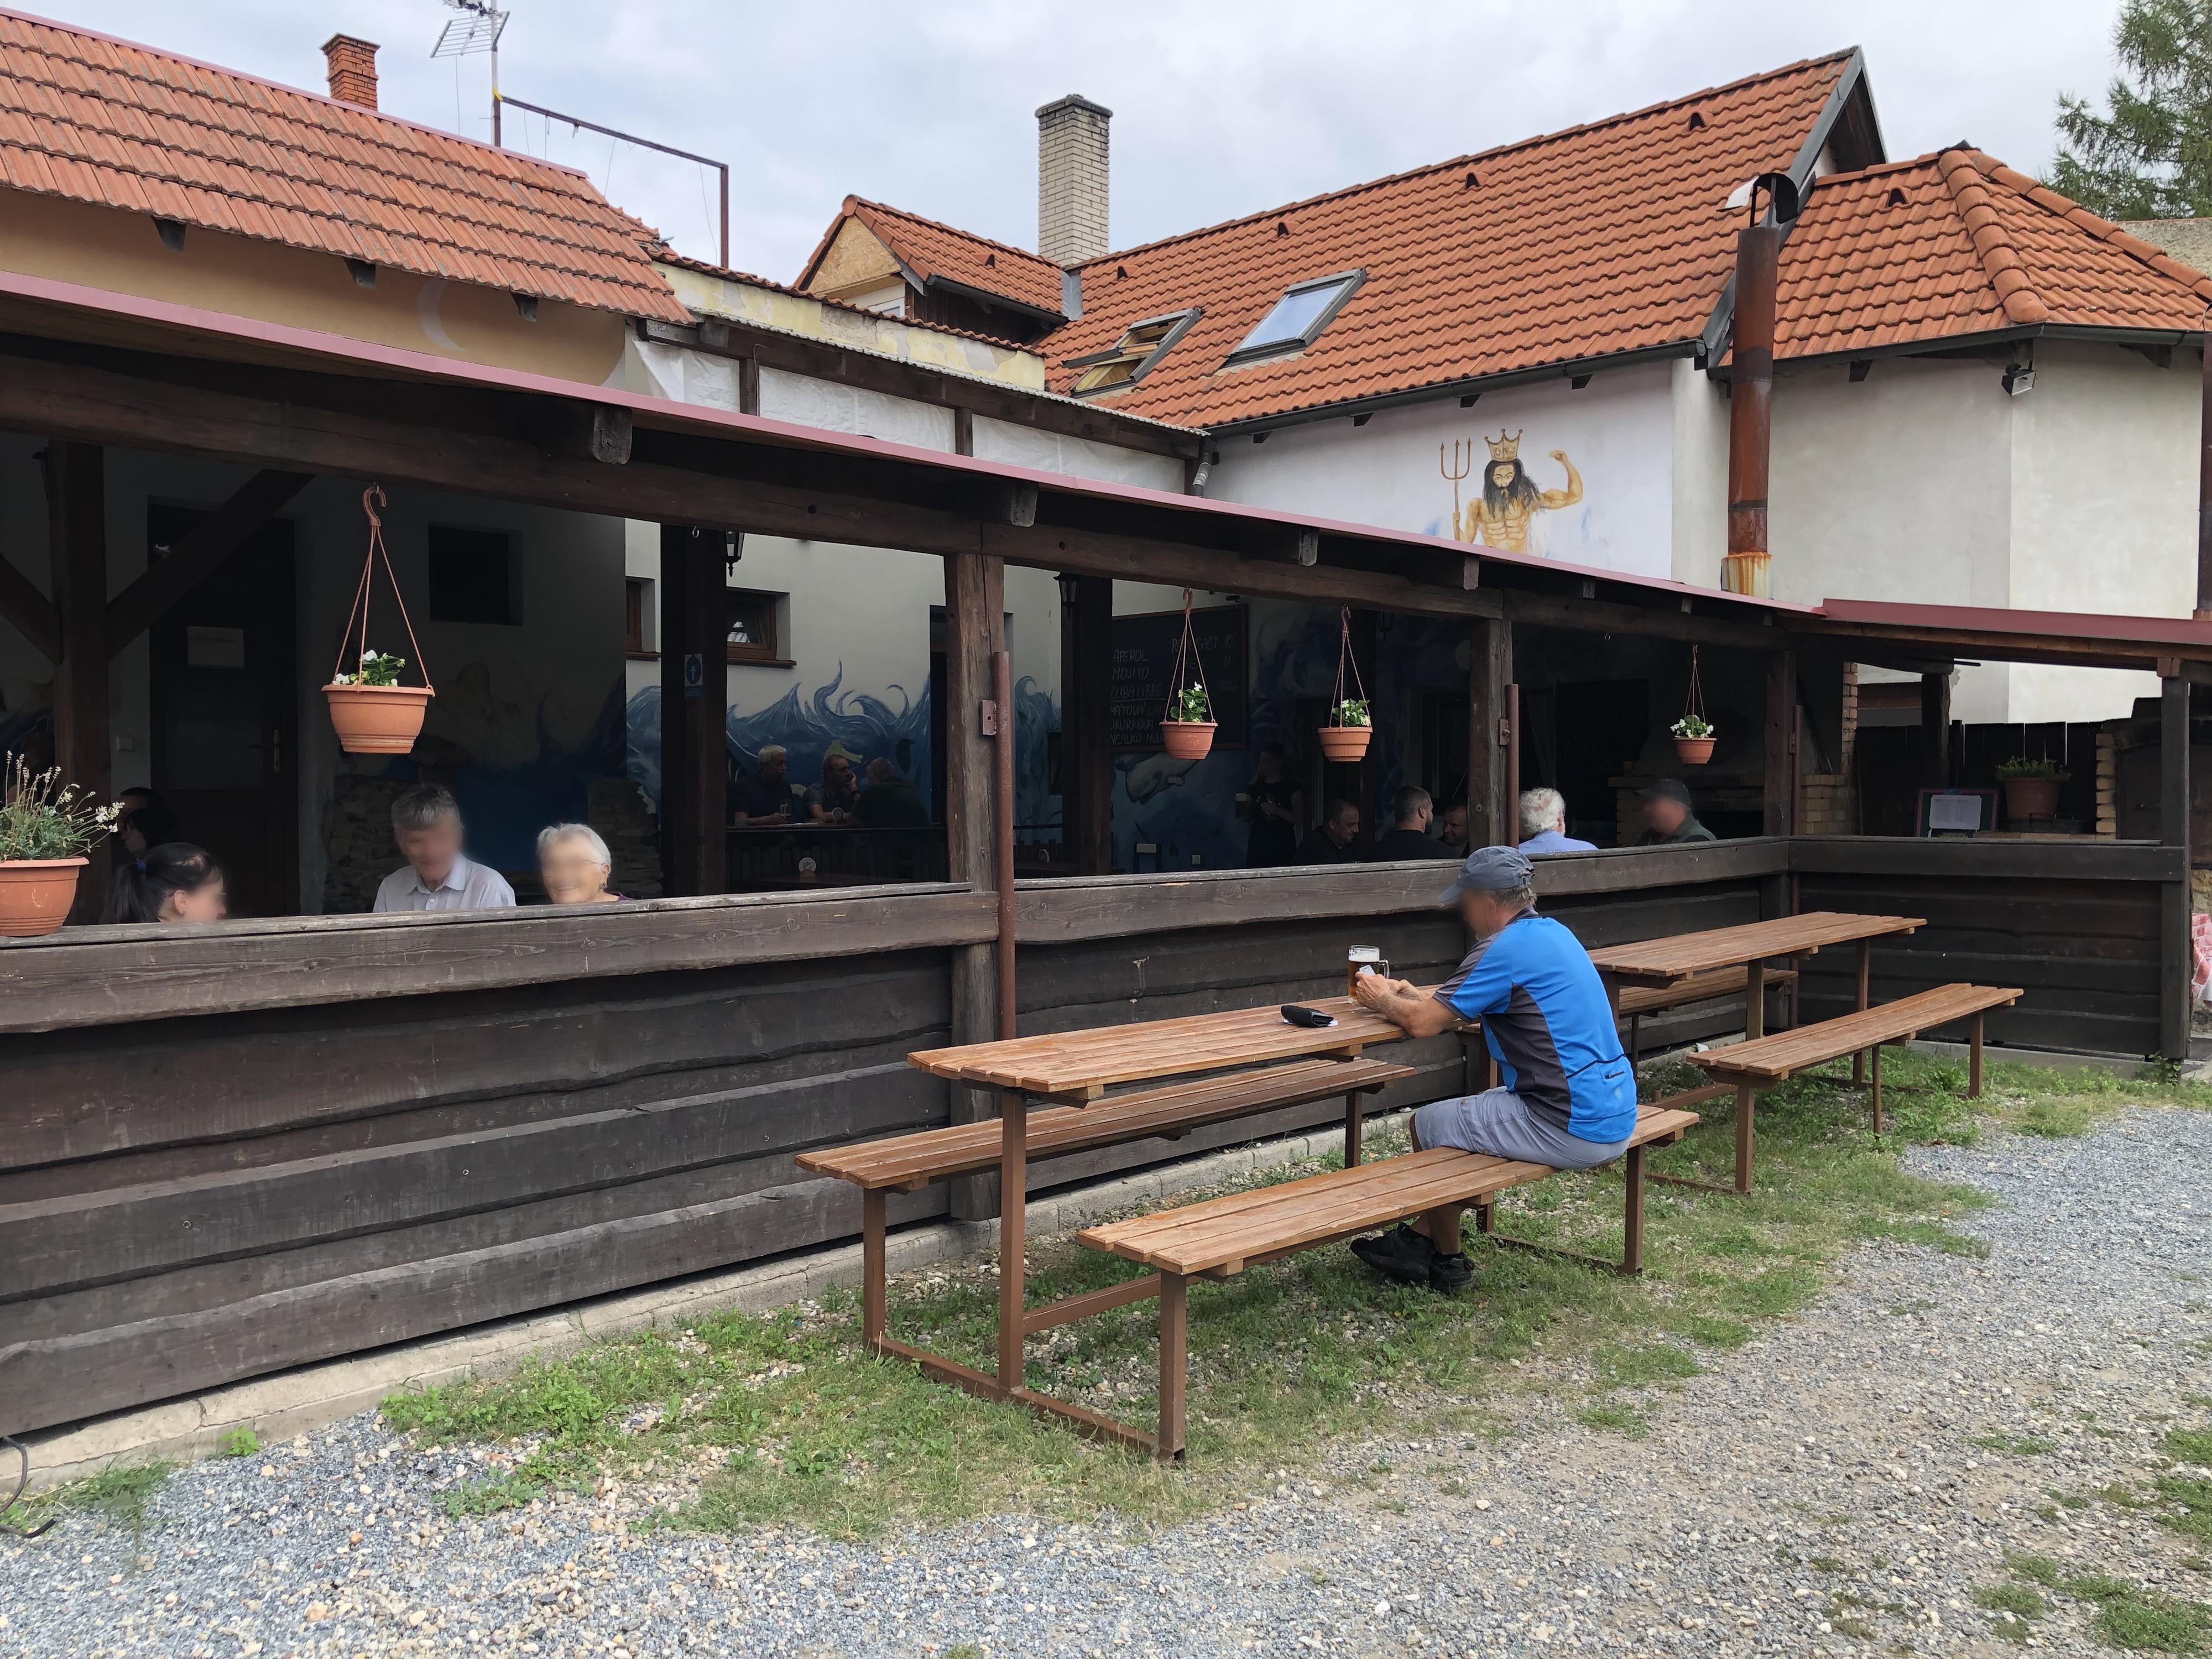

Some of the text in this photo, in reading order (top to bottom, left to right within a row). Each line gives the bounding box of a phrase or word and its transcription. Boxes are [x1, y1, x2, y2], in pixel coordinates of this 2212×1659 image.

[1114, 649, 1149, 662] APEROL
[1112, 667, 1149, 681] MOJITO
[1111, 684, 1162, 699] CUBA LIBRE
